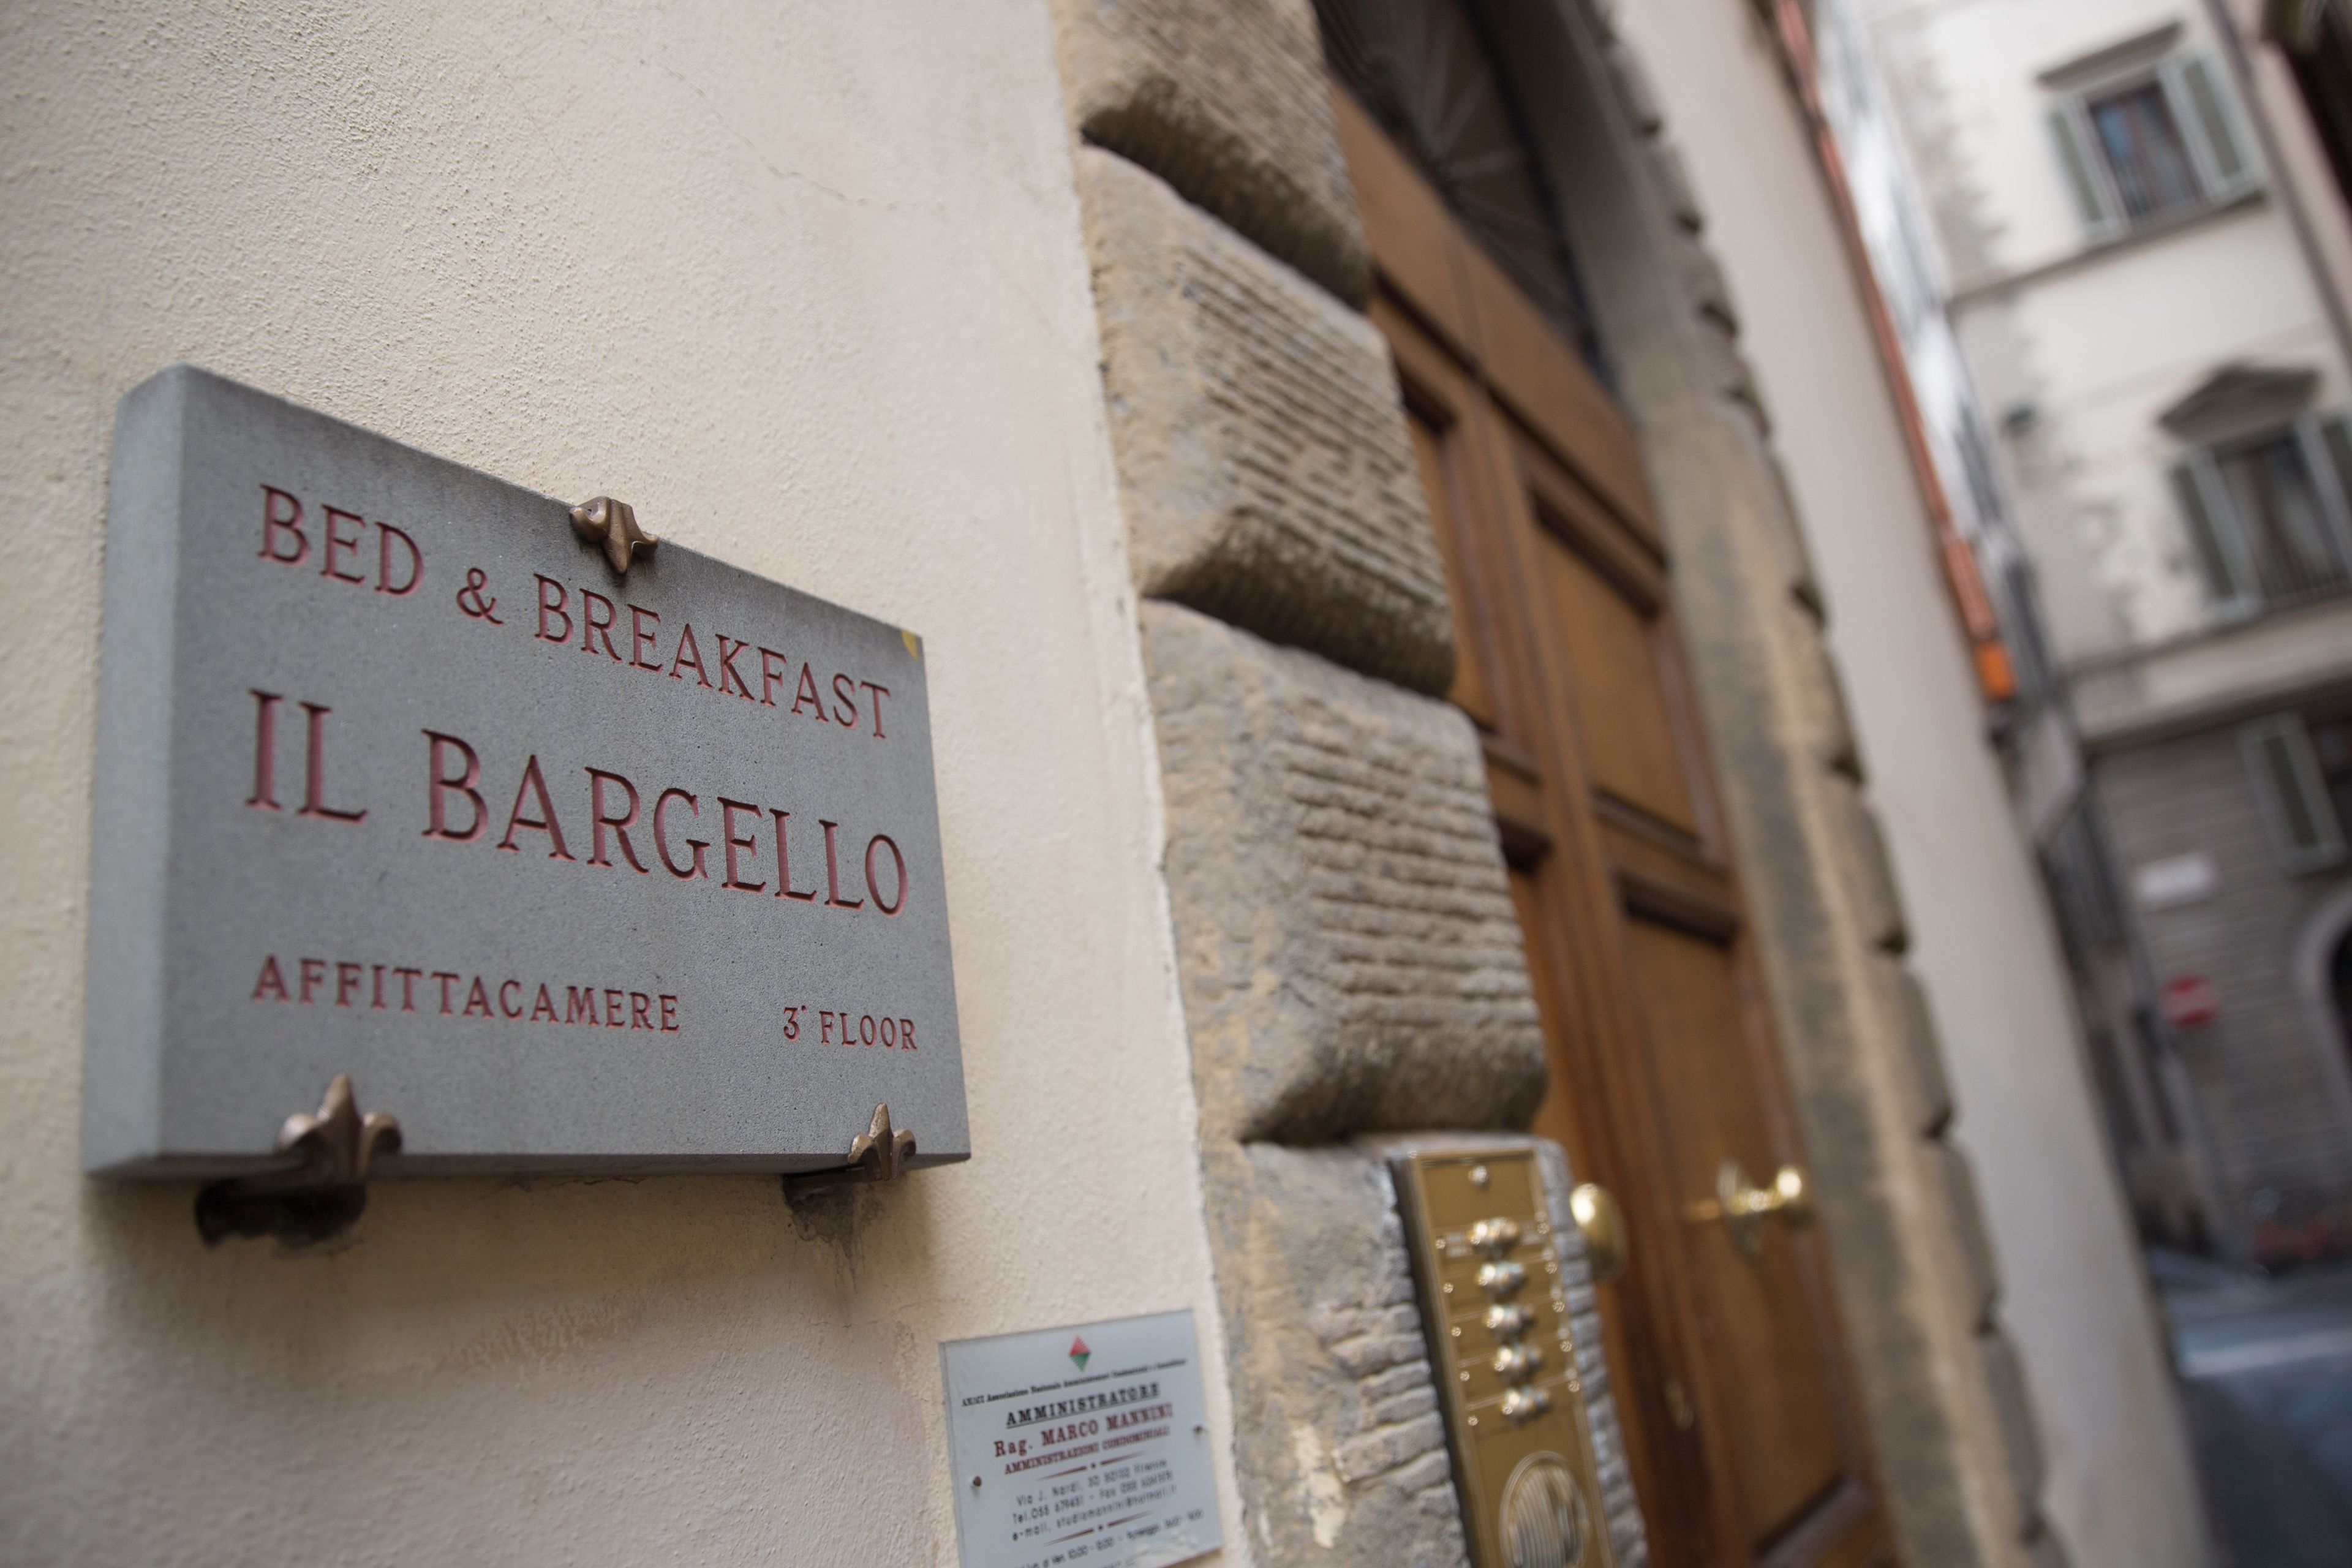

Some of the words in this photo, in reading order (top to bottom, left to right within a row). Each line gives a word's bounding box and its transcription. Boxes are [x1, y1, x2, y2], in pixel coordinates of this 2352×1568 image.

[258, 484, 424, 598] BED
[456, 568, 505, 627] &
[534, 573, 892, 741] BREAKFAST
[246, 690, 368, 827] IL
[421, 729, 908, 918] BARGELLO
[252, 956, 681, 1035] AFFITTACAMERE
[819, 1011, 918, 1052] FLOOR
[994, 1439, 1033, 1458] Rag.
[1041, 1418, 1099, 1446] MARCO
[1006, 1382, 1159, 1427] AMMINISTRATORE
